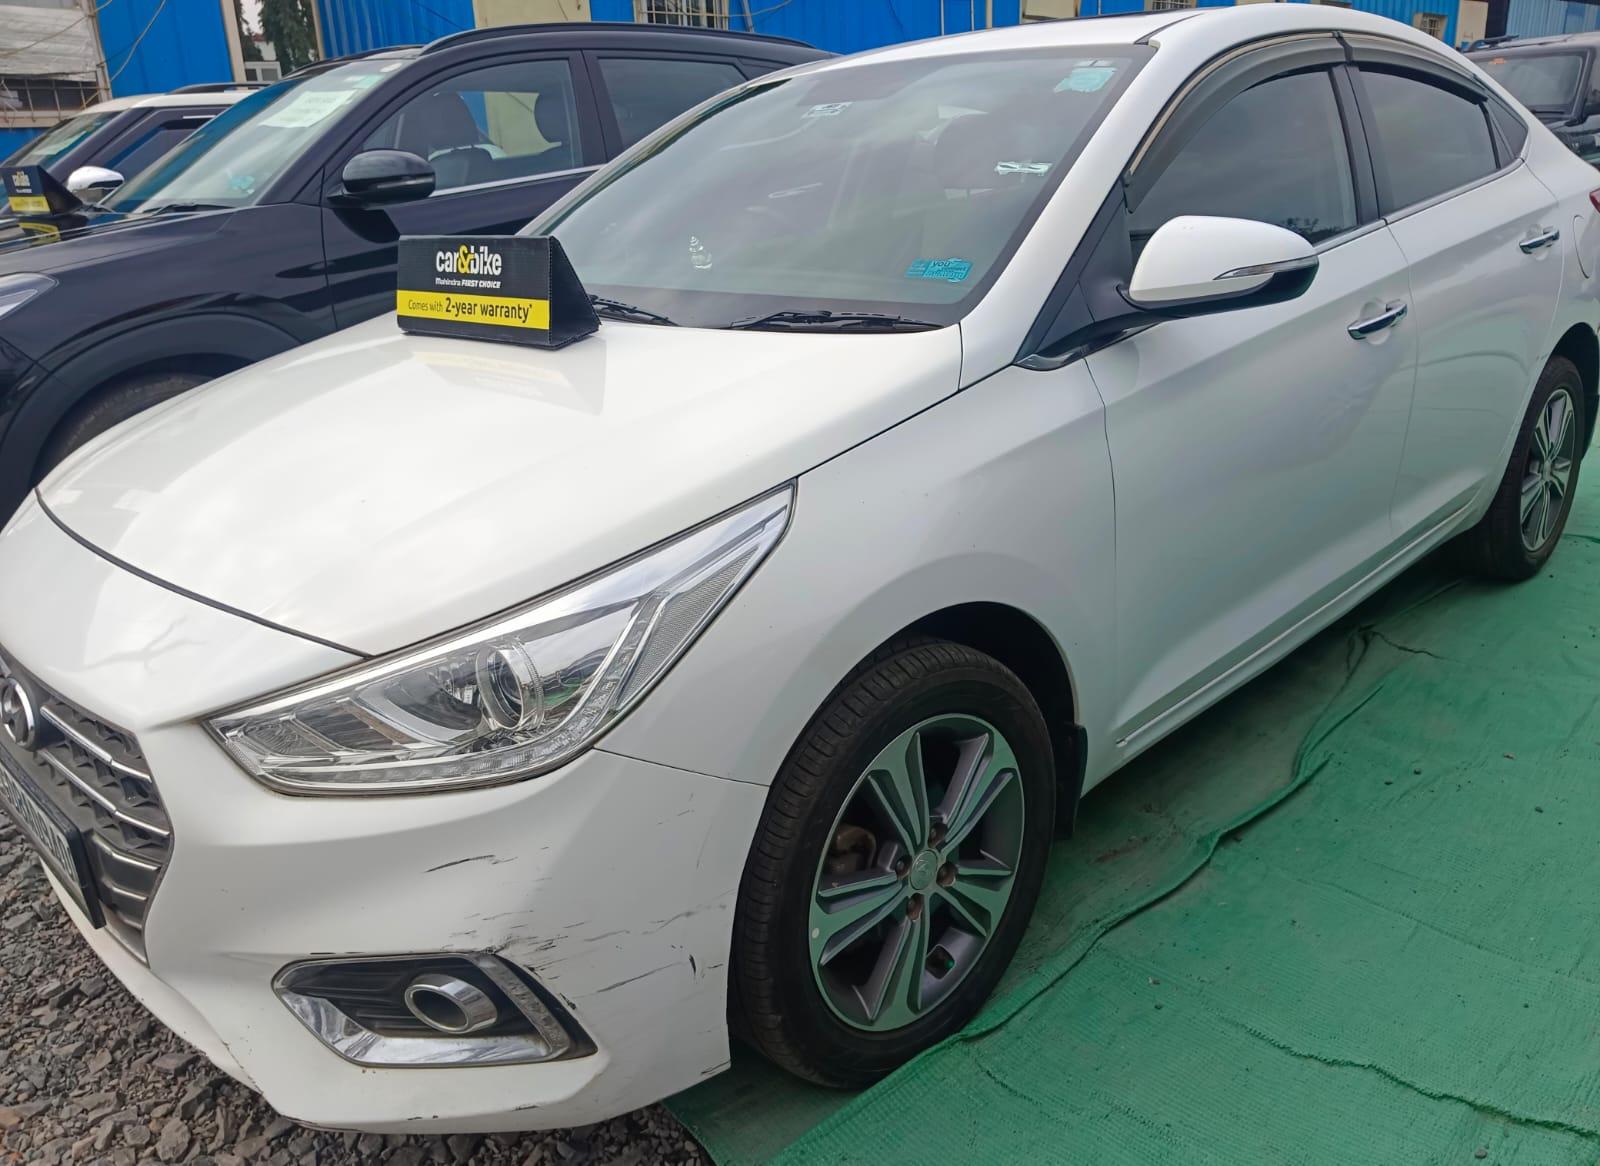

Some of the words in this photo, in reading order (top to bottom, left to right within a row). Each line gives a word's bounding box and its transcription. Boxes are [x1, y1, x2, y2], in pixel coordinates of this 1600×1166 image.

[436, 244, 502, 276] car&bike
[435, 277, 461, 286] Mahindra
[461, 279, 478, 288] FIRST
[479, 281, 501, 289] CHOICE
[408, 299, 429, 312] Comes
[429, 300, 443, 313] with
[445, 297, 478, 317] 2-year
